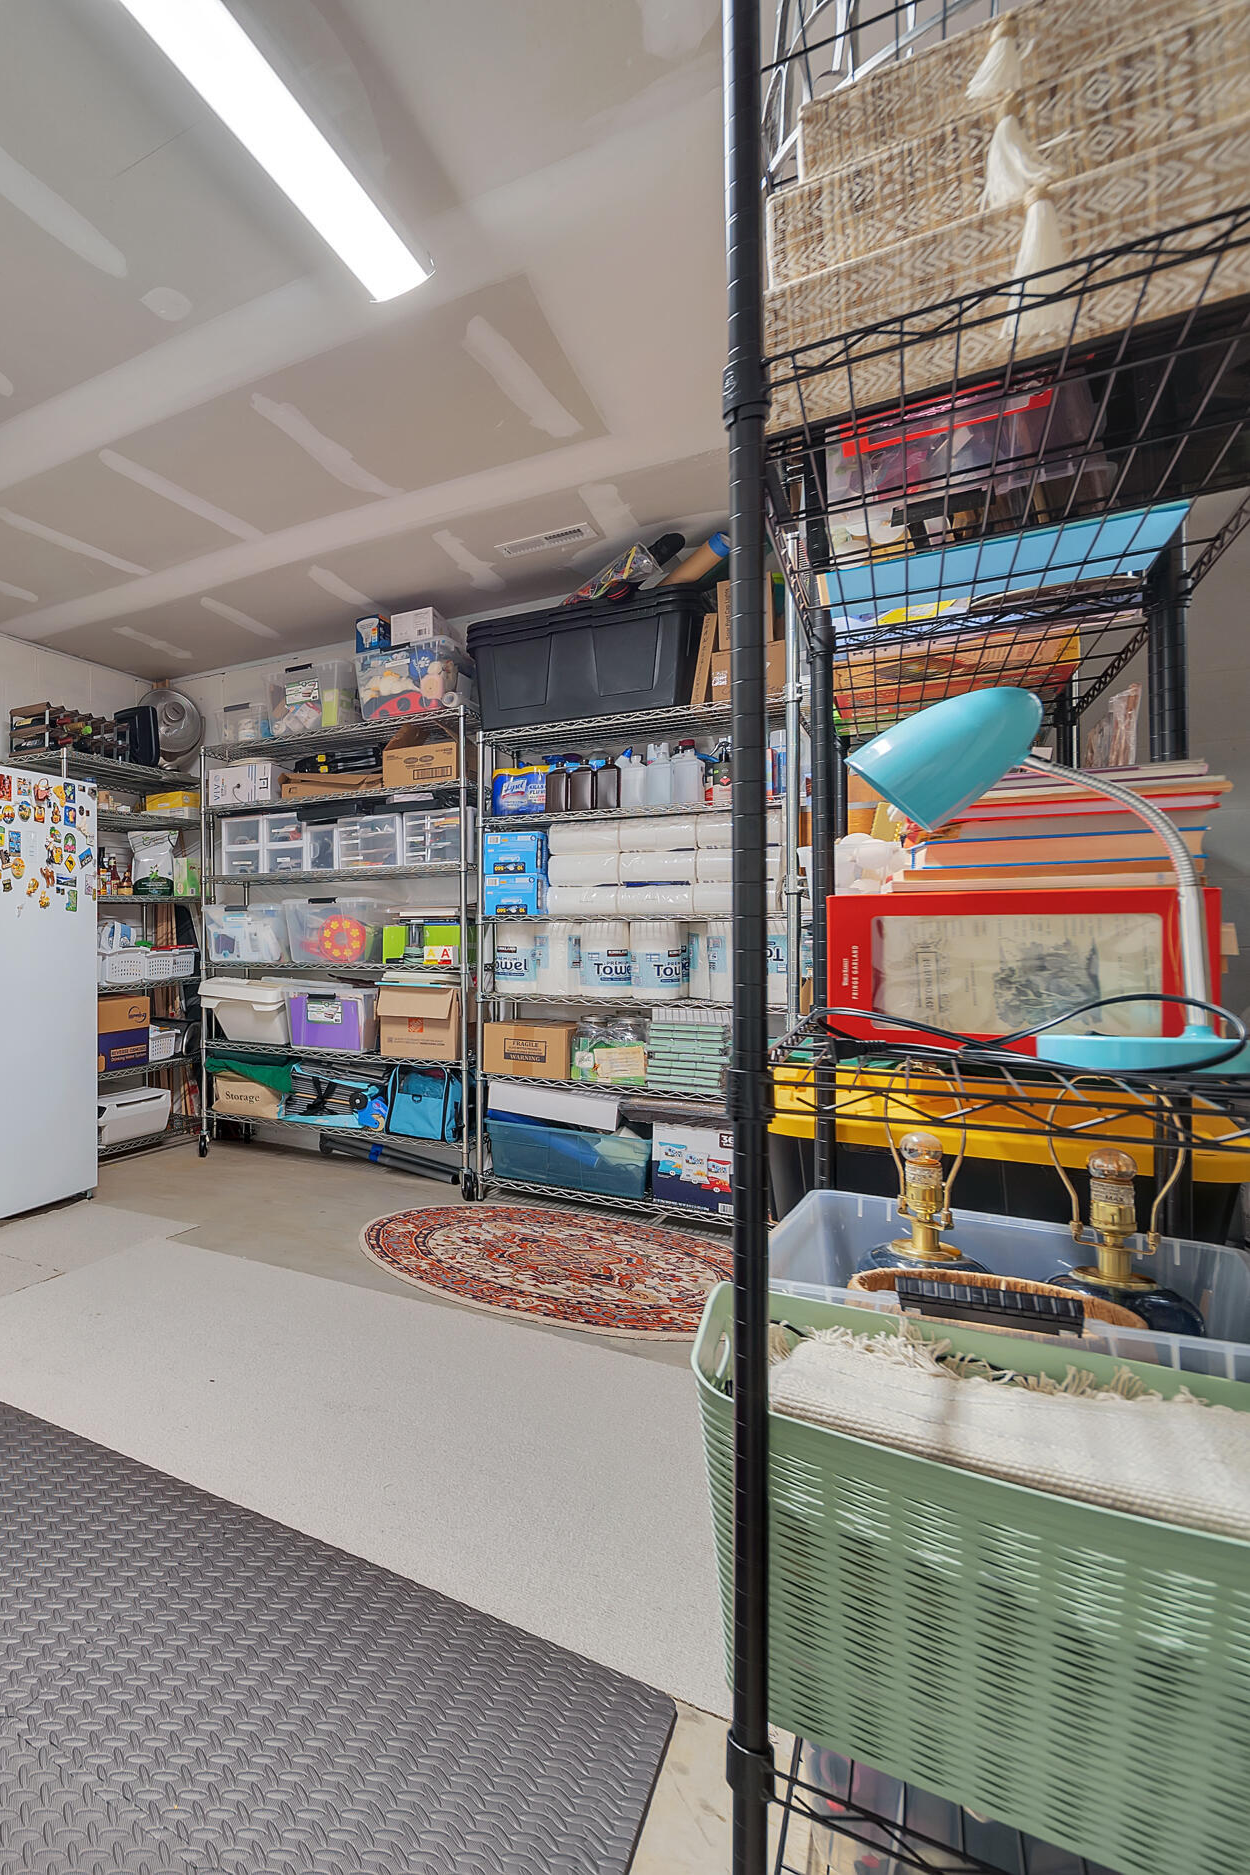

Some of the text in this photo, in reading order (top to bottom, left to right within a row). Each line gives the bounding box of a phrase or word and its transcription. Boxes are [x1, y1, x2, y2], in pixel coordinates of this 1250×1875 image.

[504, 781, 524, 792] Lysol
[495, 959, 528, 971] wel
[594, 962, 631, 975] Towe
[851, 945, 859, 1000] FRINGE GARLAND
[510, 1053, 540, 1062] WARNING
[225, 1091, 260, 1104] Storage
